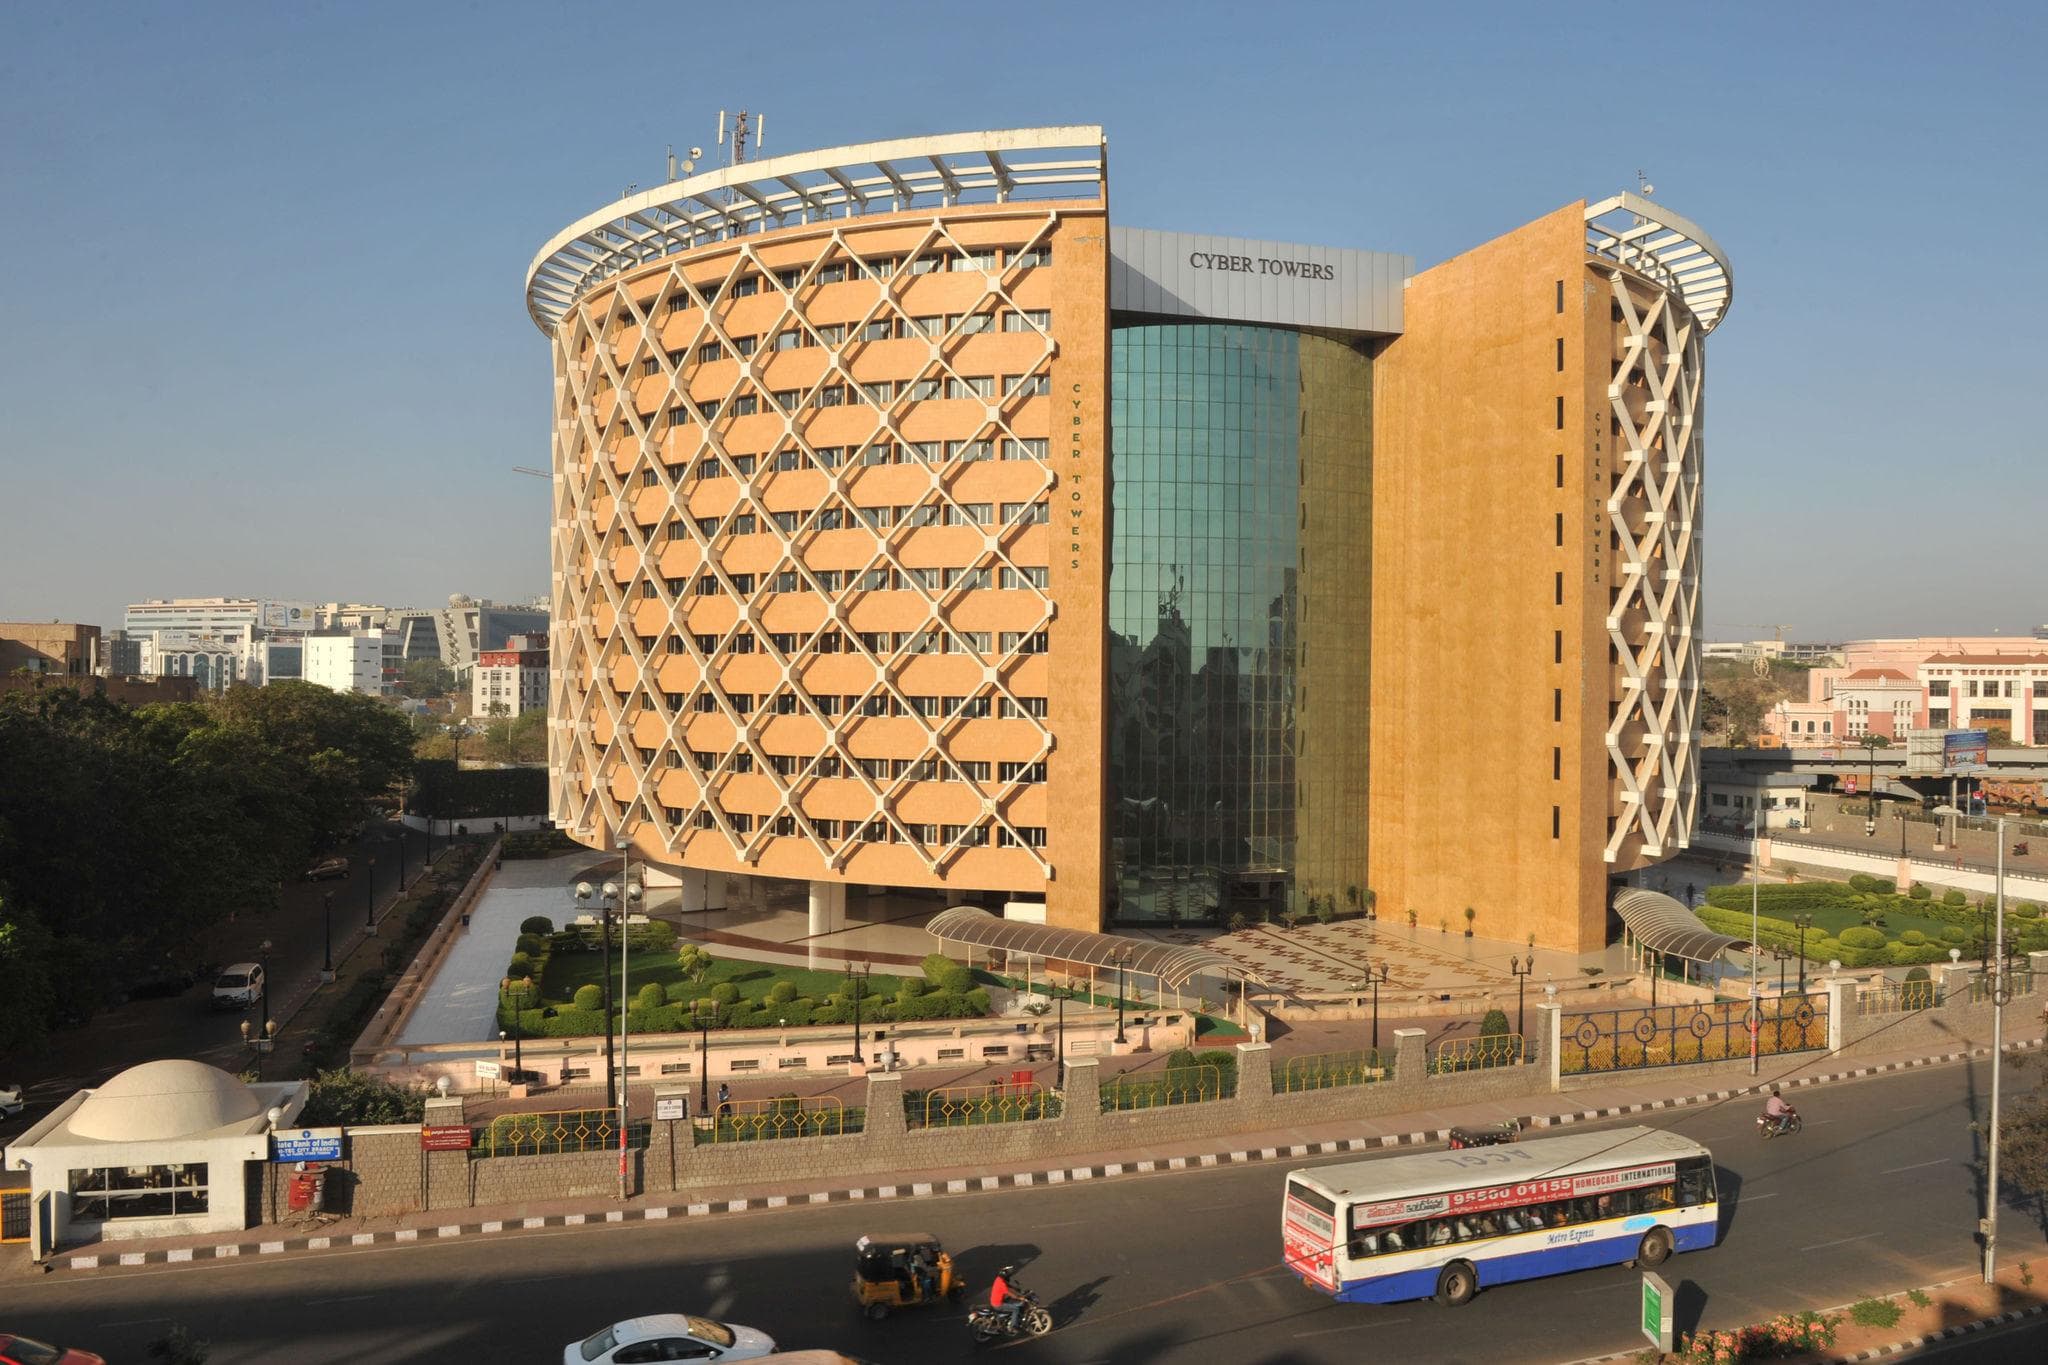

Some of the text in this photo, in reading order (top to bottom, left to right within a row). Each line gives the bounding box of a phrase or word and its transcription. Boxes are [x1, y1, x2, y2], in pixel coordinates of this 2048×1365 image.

[1190, 252, 1334, 280] CYBER TOWERS
[1071, 384, 1083, 569] CYBER TOWERS
[1517, 1179, 1571, 1196] 01155
[1575, 1174, 1619, 1188] HOMEOCARE
[1621, 1165, 1675, 1181] INTERNATIONAL
[1547, 1229, 1594, 1244] Metro Express
